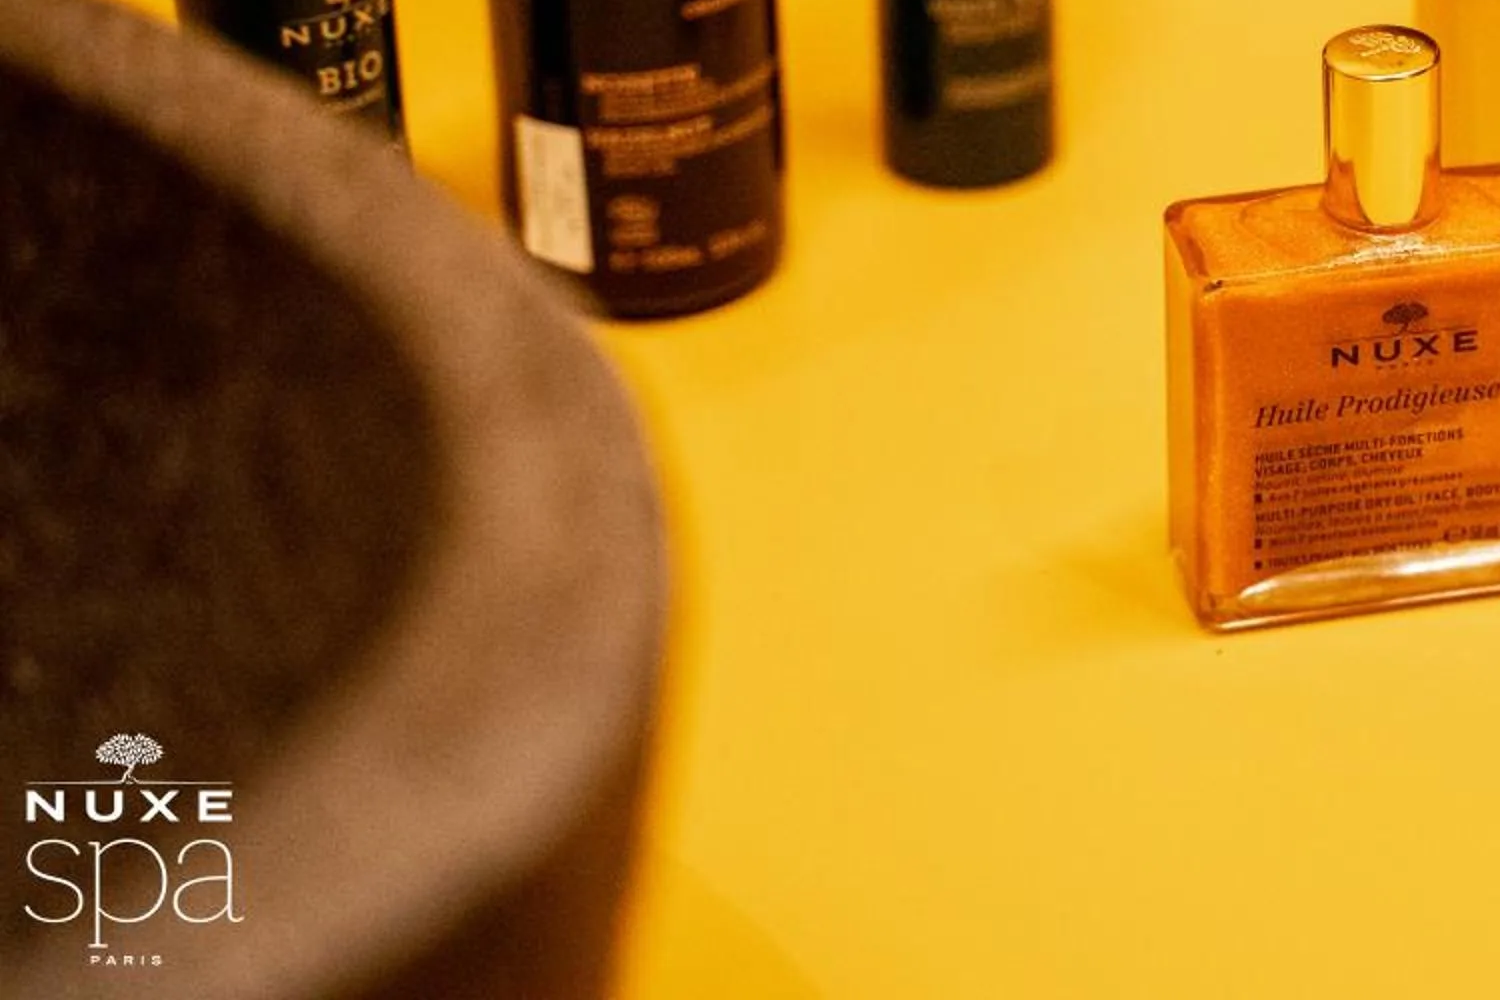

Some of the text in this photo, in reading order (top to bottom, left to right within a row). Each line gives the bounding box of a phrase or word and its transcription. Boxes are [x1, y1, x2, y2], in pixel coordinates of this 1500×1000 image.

[317, 50, 383, 95] BIO
[1331, 331, 1478, 369] NUXE
[1254, 398, 1329, 429] Huile
[1255, 449, 1298, 466] HUILE
[1361, 448, 1423, 464] CHEVEUX
